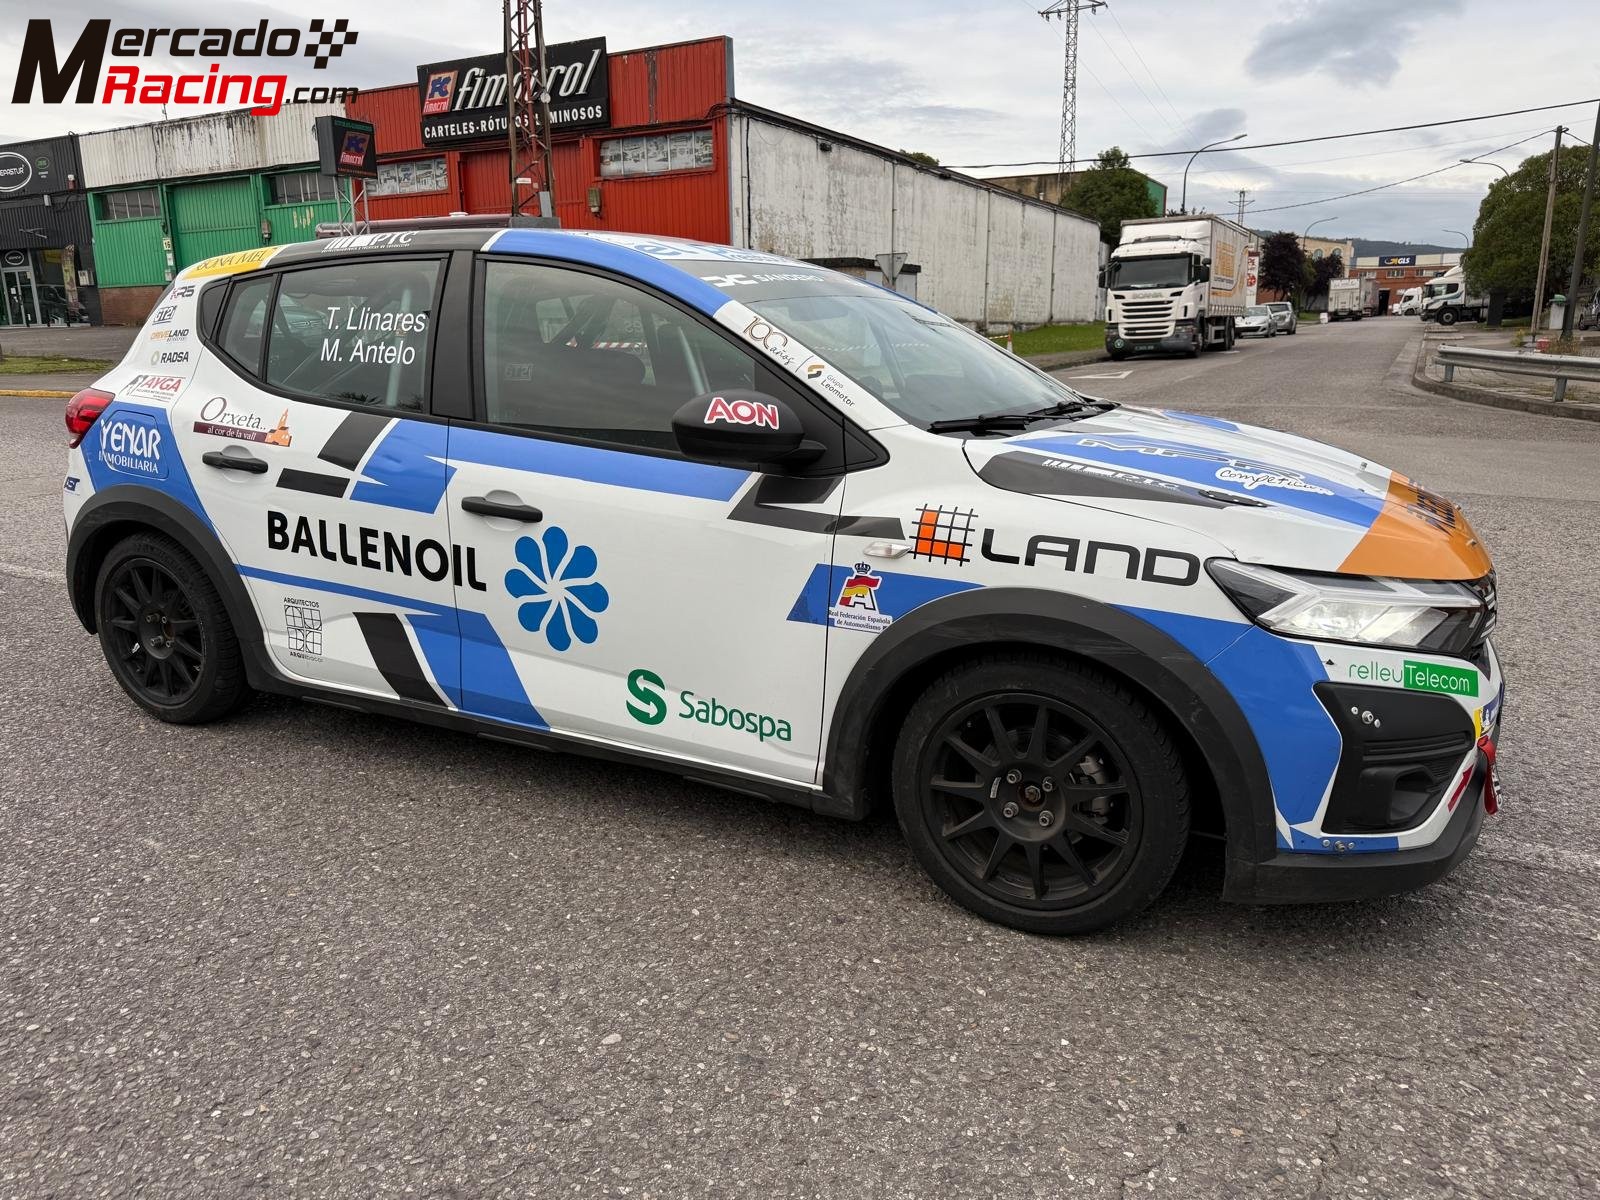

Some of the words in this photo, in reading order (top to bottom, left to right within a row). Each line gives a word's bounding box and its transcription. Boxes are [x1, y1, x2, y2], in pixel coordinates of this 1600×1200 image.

[535, 104, 602, 127] LMINOSOS
[327, 307, 340, 330] T.
[346, 306, 427, 333] Llinares
[160, 351, 189, 364] RADSA
[320, 338, 343, 362] M.
[349, 338, 416, 365] Antelo
[141, 376, 182, 393] AYGA
[820, 379, 856, 408] Leomotor
[705, 398, 779, 430] AON
[101, 418, 161, 460] YENAR
[207, 425, 215, 434] al
[215, 427, 225, 436] cor
[226, 428, 235, 438] de
[243, 431, 257, 441] vall
[267, 510, 488, 592] BALLENOIL
[980, 527, 1201, 587] LAND
[283, 597, 320, 608] ARQUITECTOS
[839, 611, 867, 621] Federación
[867, 615, 891, 625] Española
[678, 690, 792, 742] Sabospa
